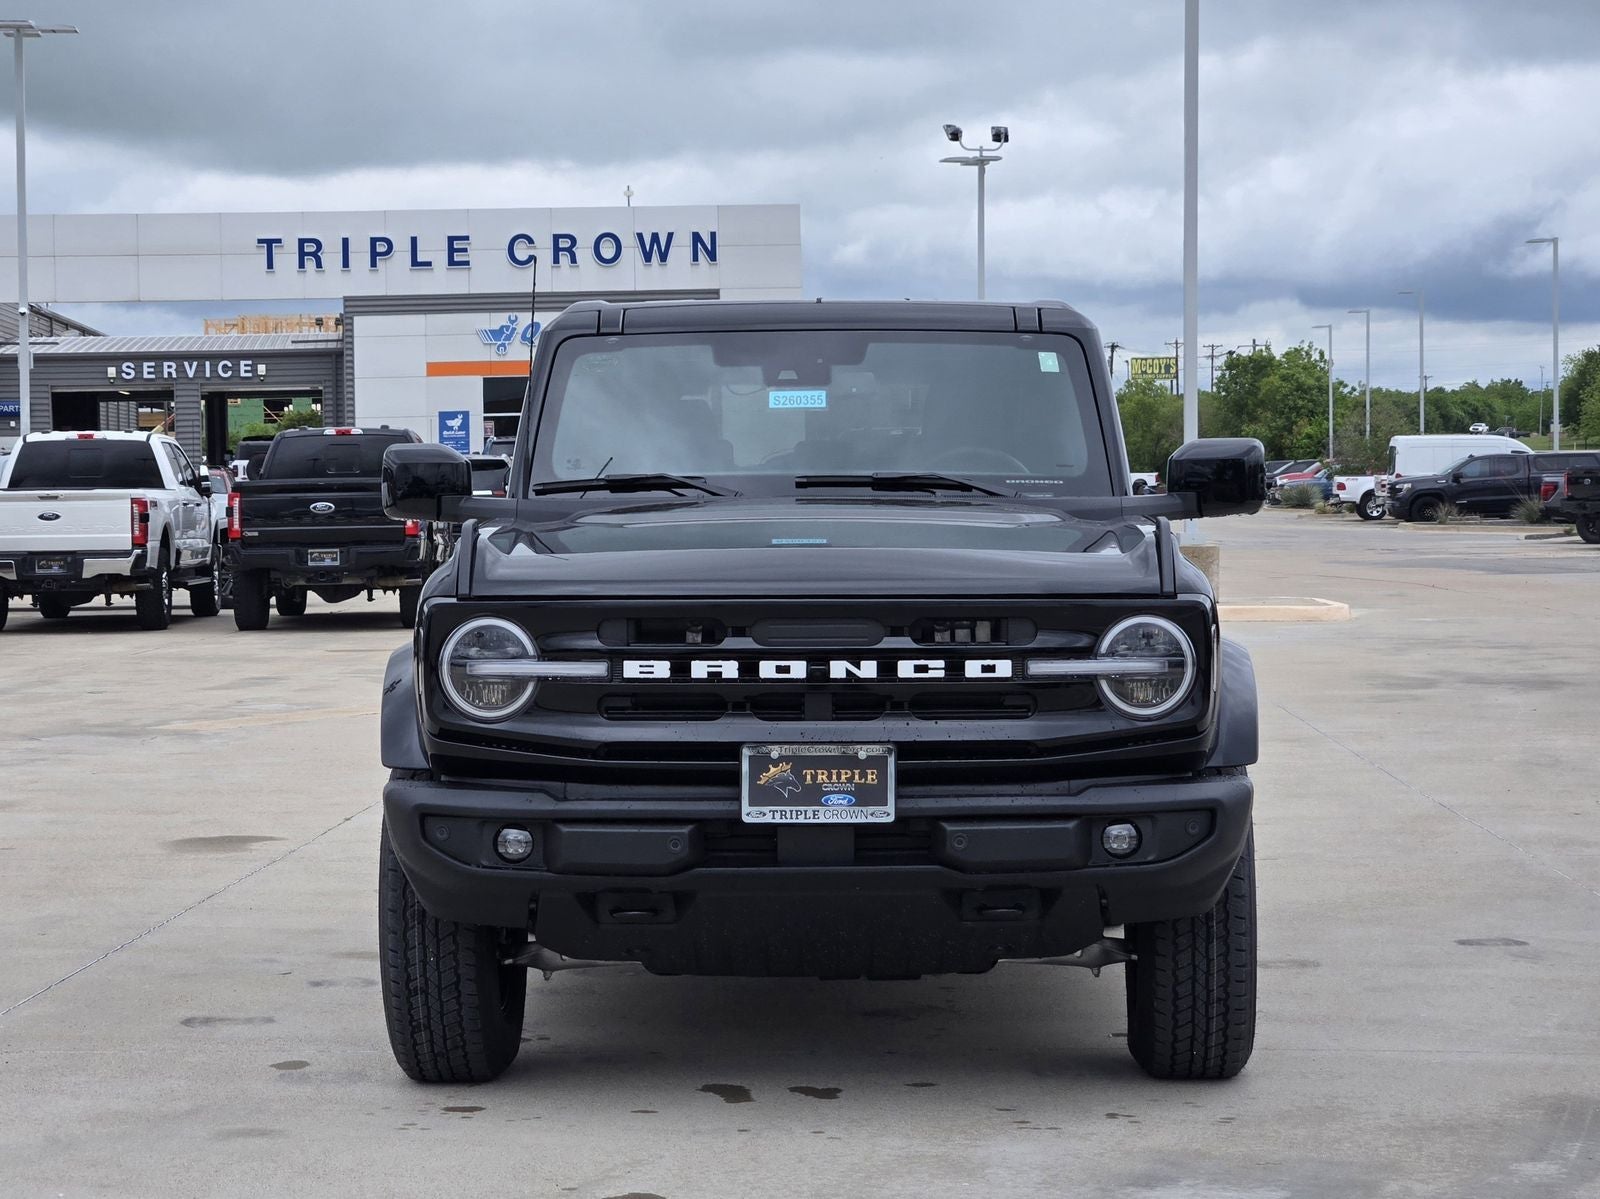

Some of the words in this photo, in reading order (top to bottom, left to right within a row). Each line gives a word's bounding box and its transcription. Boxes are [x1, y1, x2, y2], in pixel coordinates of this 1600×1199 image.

[256, 235, 471, 272] TRIPLE
[506, 231, 719, 268] CROWN
[121, 360, 253, 379] SERVICE
[773, 395, 823, 405] S260355
[622, 660, 1012, 678] BRONCO
[802, 769, 878, 784] TRIPLE
[822, 783, 855, 791] CROWN
[769, 809, 820, 820] TRIPLE
[823, 809, 869, 820] CROWN
